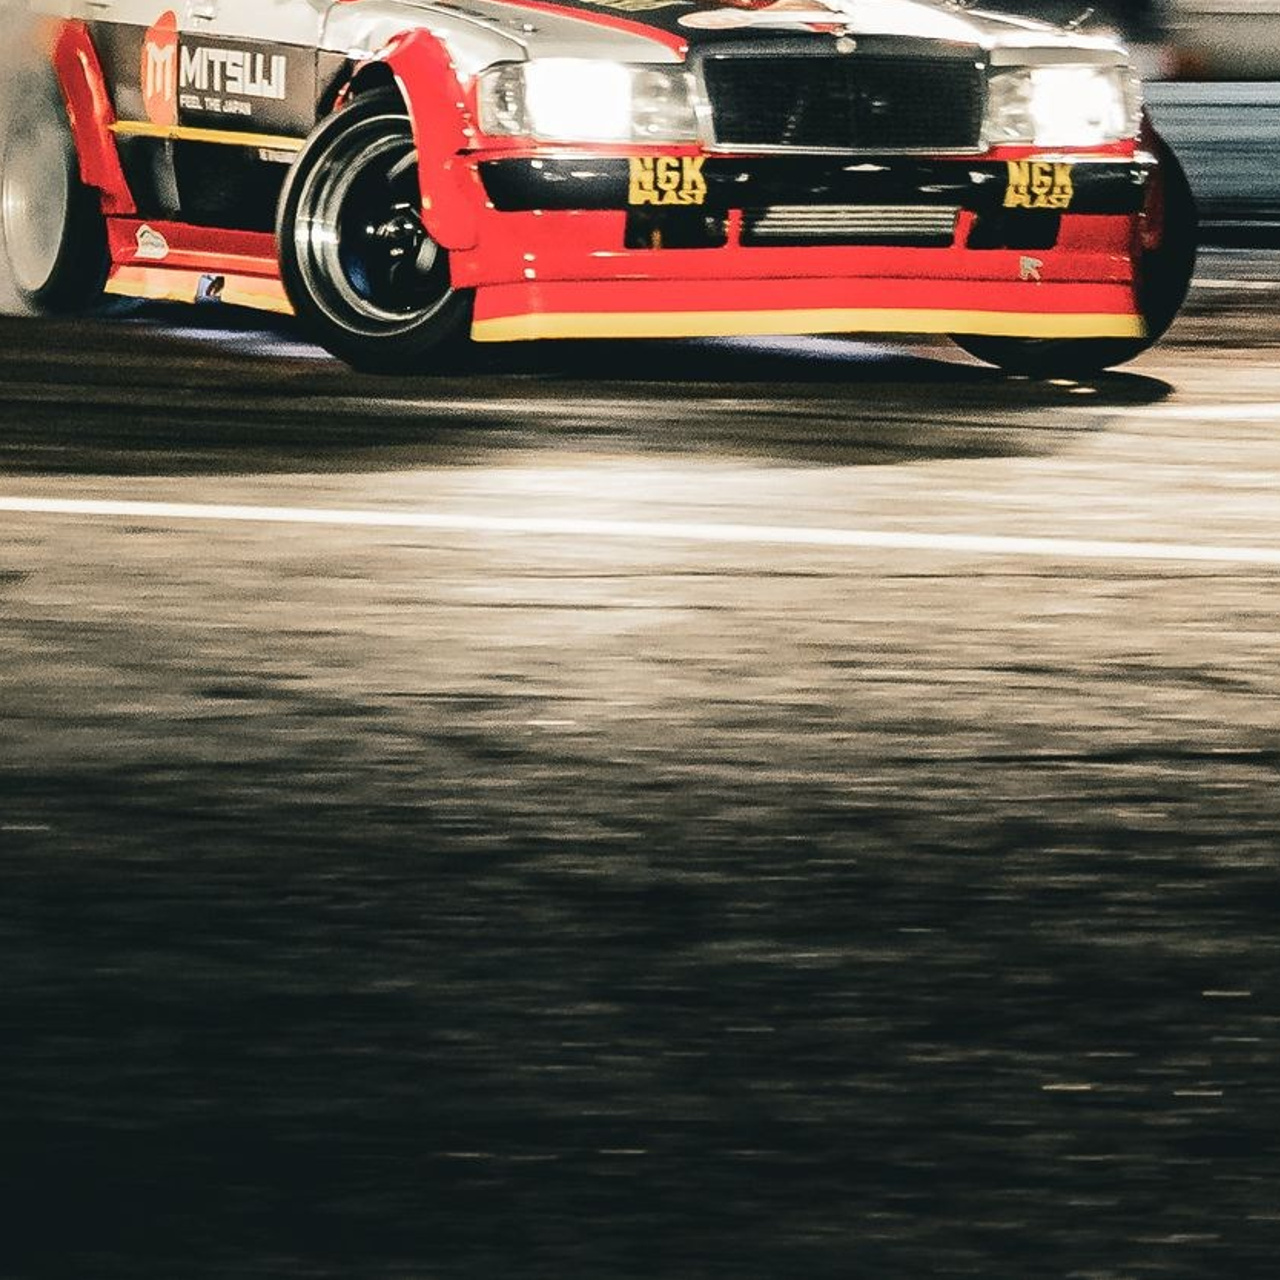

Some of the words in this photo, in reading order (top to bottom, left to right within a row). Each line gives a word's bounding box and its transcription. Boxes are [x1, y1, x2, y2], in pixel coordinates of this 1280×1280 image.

[204, 97, 222, 113] THE
[628, 156, 706, 191] NGK
[1007, 161, 1073, 194] NGK
